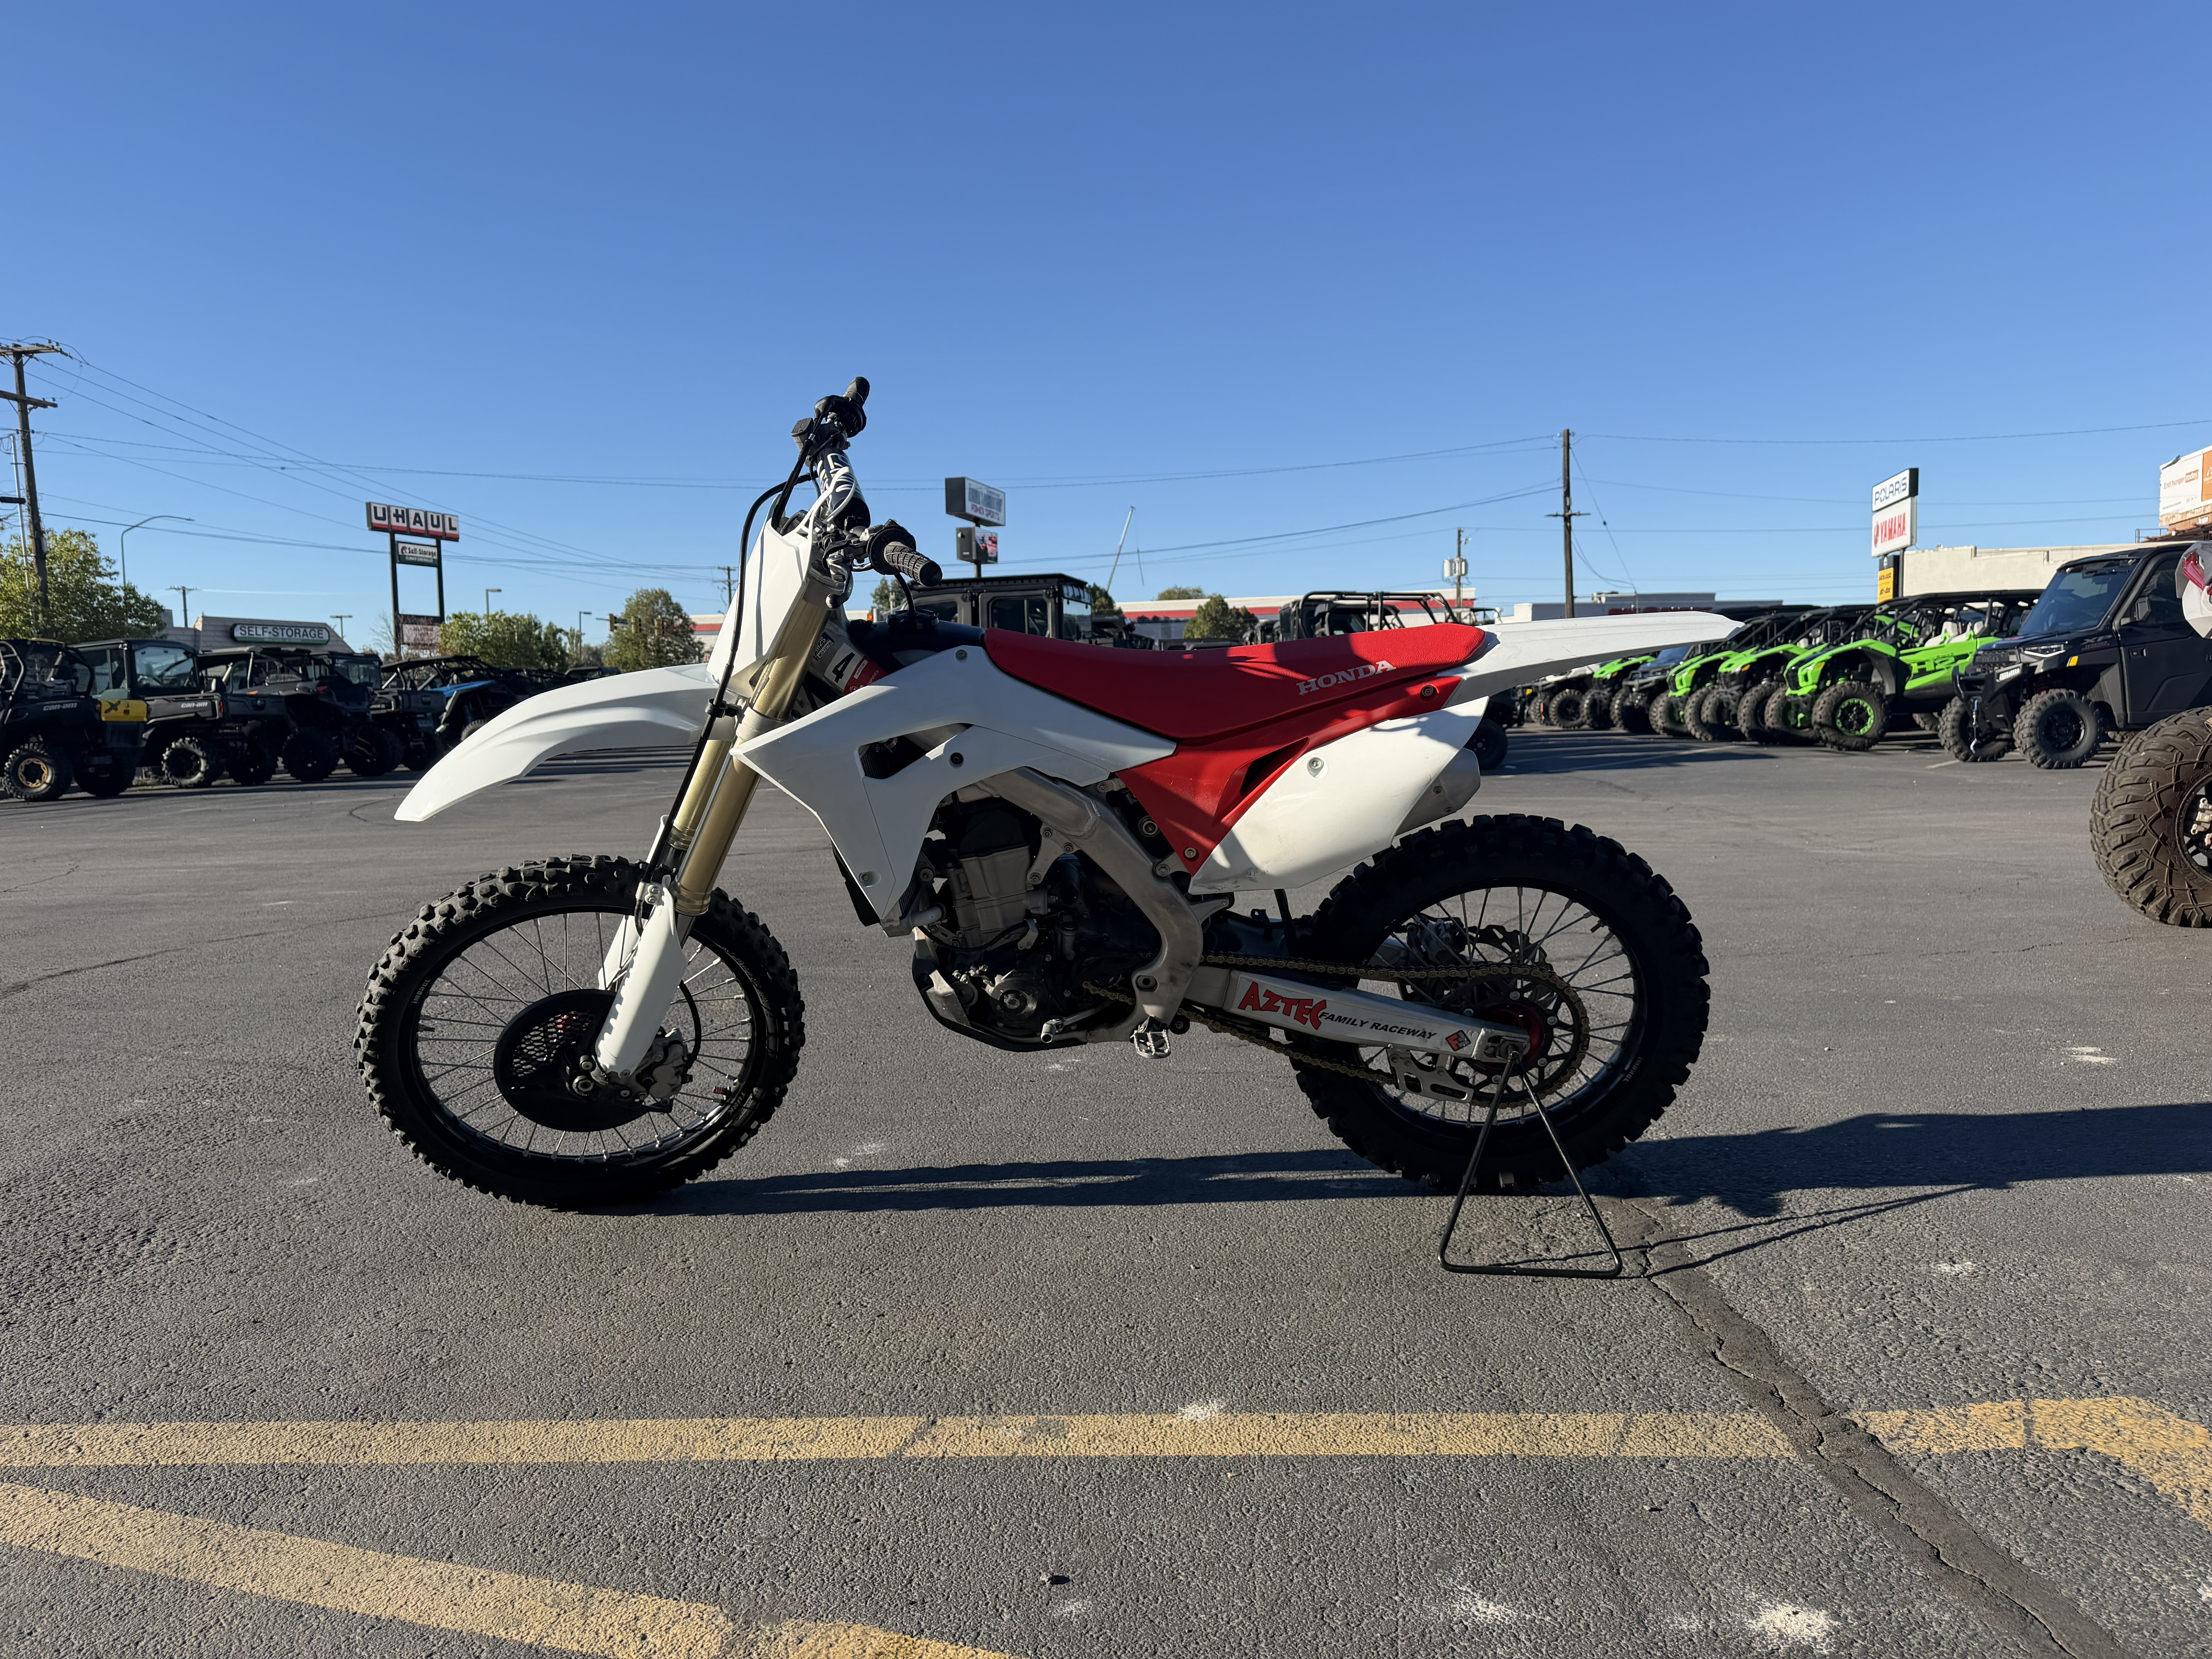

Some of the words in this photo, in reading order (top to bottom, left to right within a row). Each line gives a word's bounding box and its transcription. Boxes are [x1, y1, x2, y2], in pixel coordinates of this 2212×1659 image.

[1875, 476, 1907, 505] POLARIS
[1881, 512, 1906, 544] YAMAHA
[239, 625, 324, 639] SELF-STORAGE
[832, 652, 856, 683] 4
[1296, 660, 1396, 696] HONDA
[1237, 981, 1327, 1030] AZTEC
[1318, 1012, 1369, 1027] FAMILY
[1370, 1022, 1438, 1039] RACEWAY
[728, 1092, 746, 1115] TUSK
